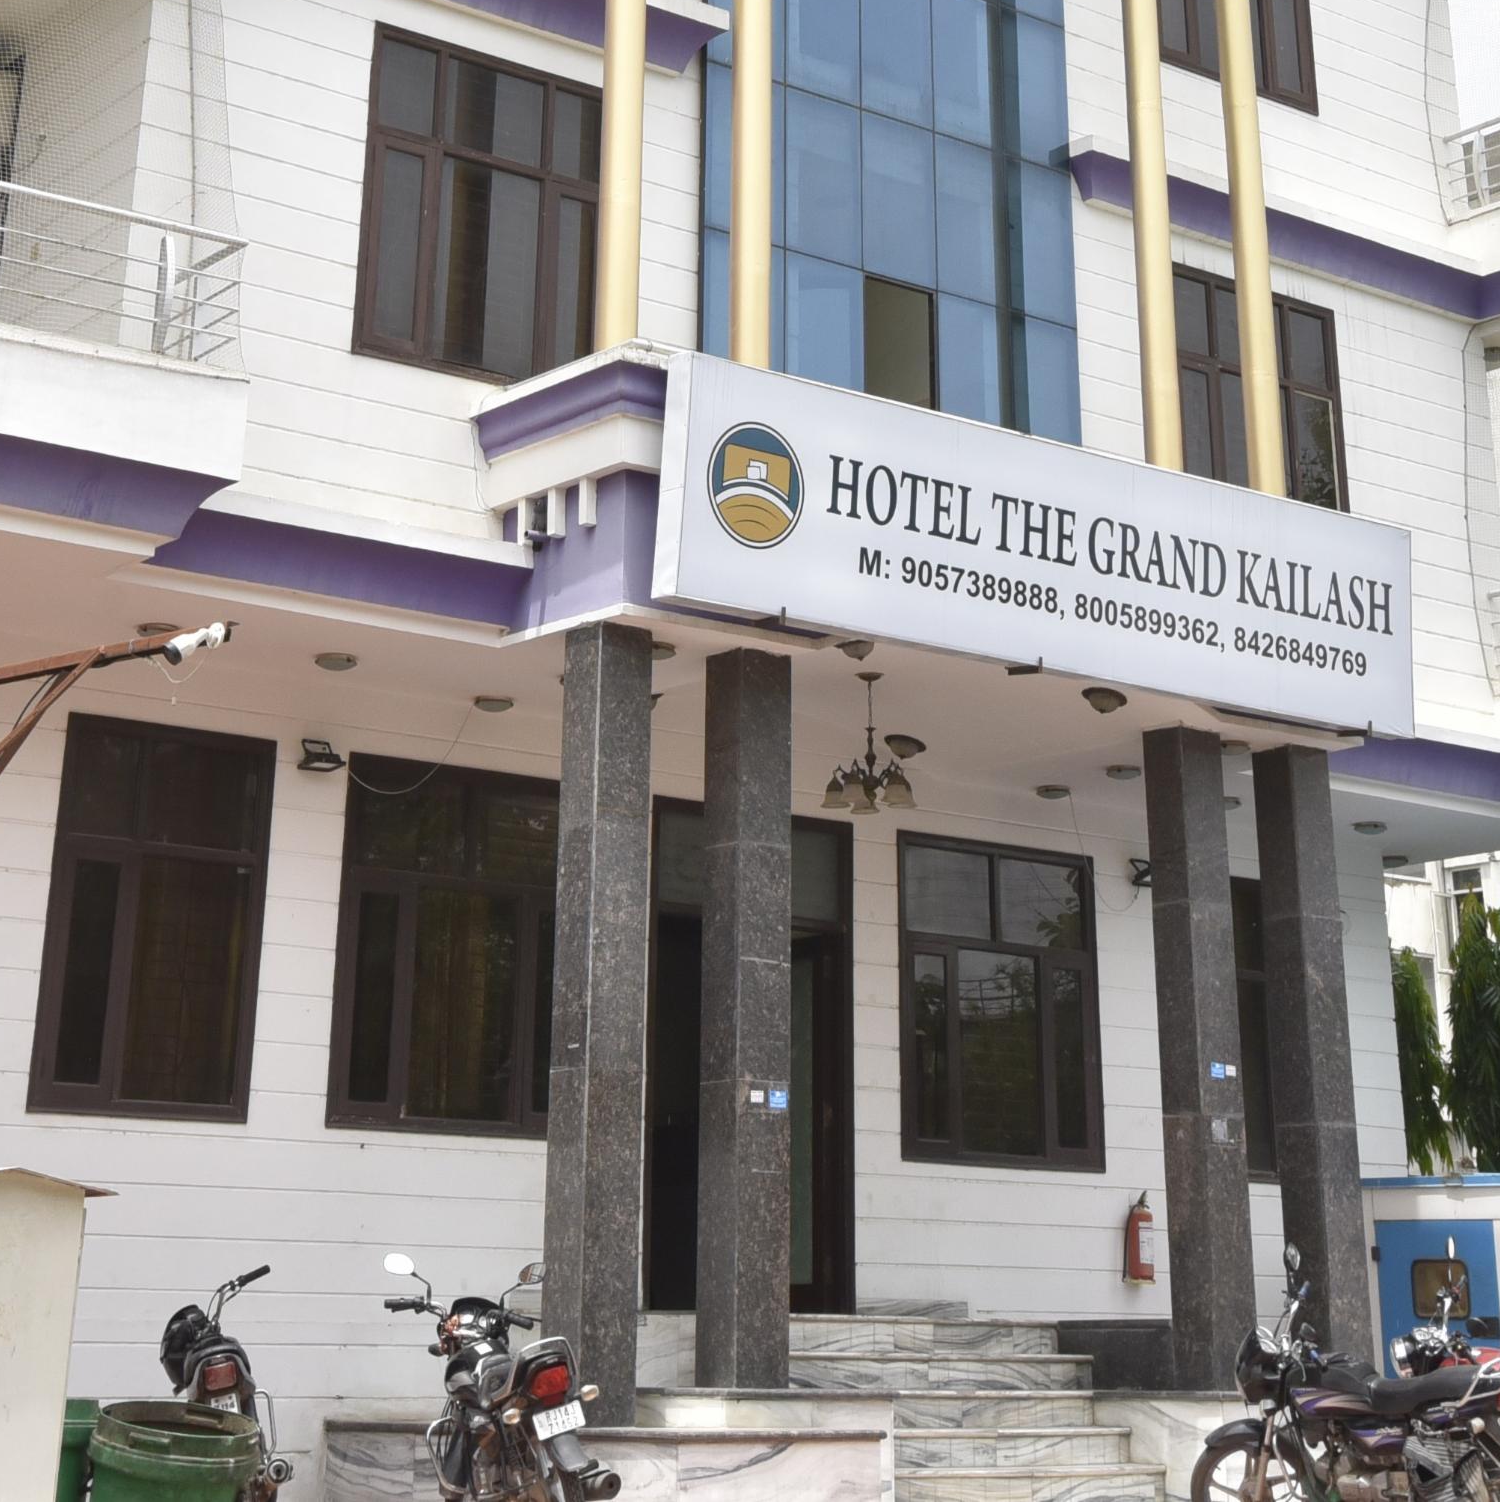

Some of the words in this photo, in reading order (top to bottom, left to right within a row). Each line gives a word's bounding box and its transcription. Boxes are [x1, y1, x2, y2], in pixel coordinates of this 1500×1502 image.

[826, 454, 982, 546] HOTEL
[991, 492, 1078, 567] THE
[1088, 517, 1227, 598] GRAND
[1236, 549, 1394, 636] KAILASH
[858, 546, 891, 580] M:
[901, 556, 1065, 620] 9057389888,
[1074, 593, 1225, 653] 8005899362,
[1234, 626, 1367, 677] 8426849769
